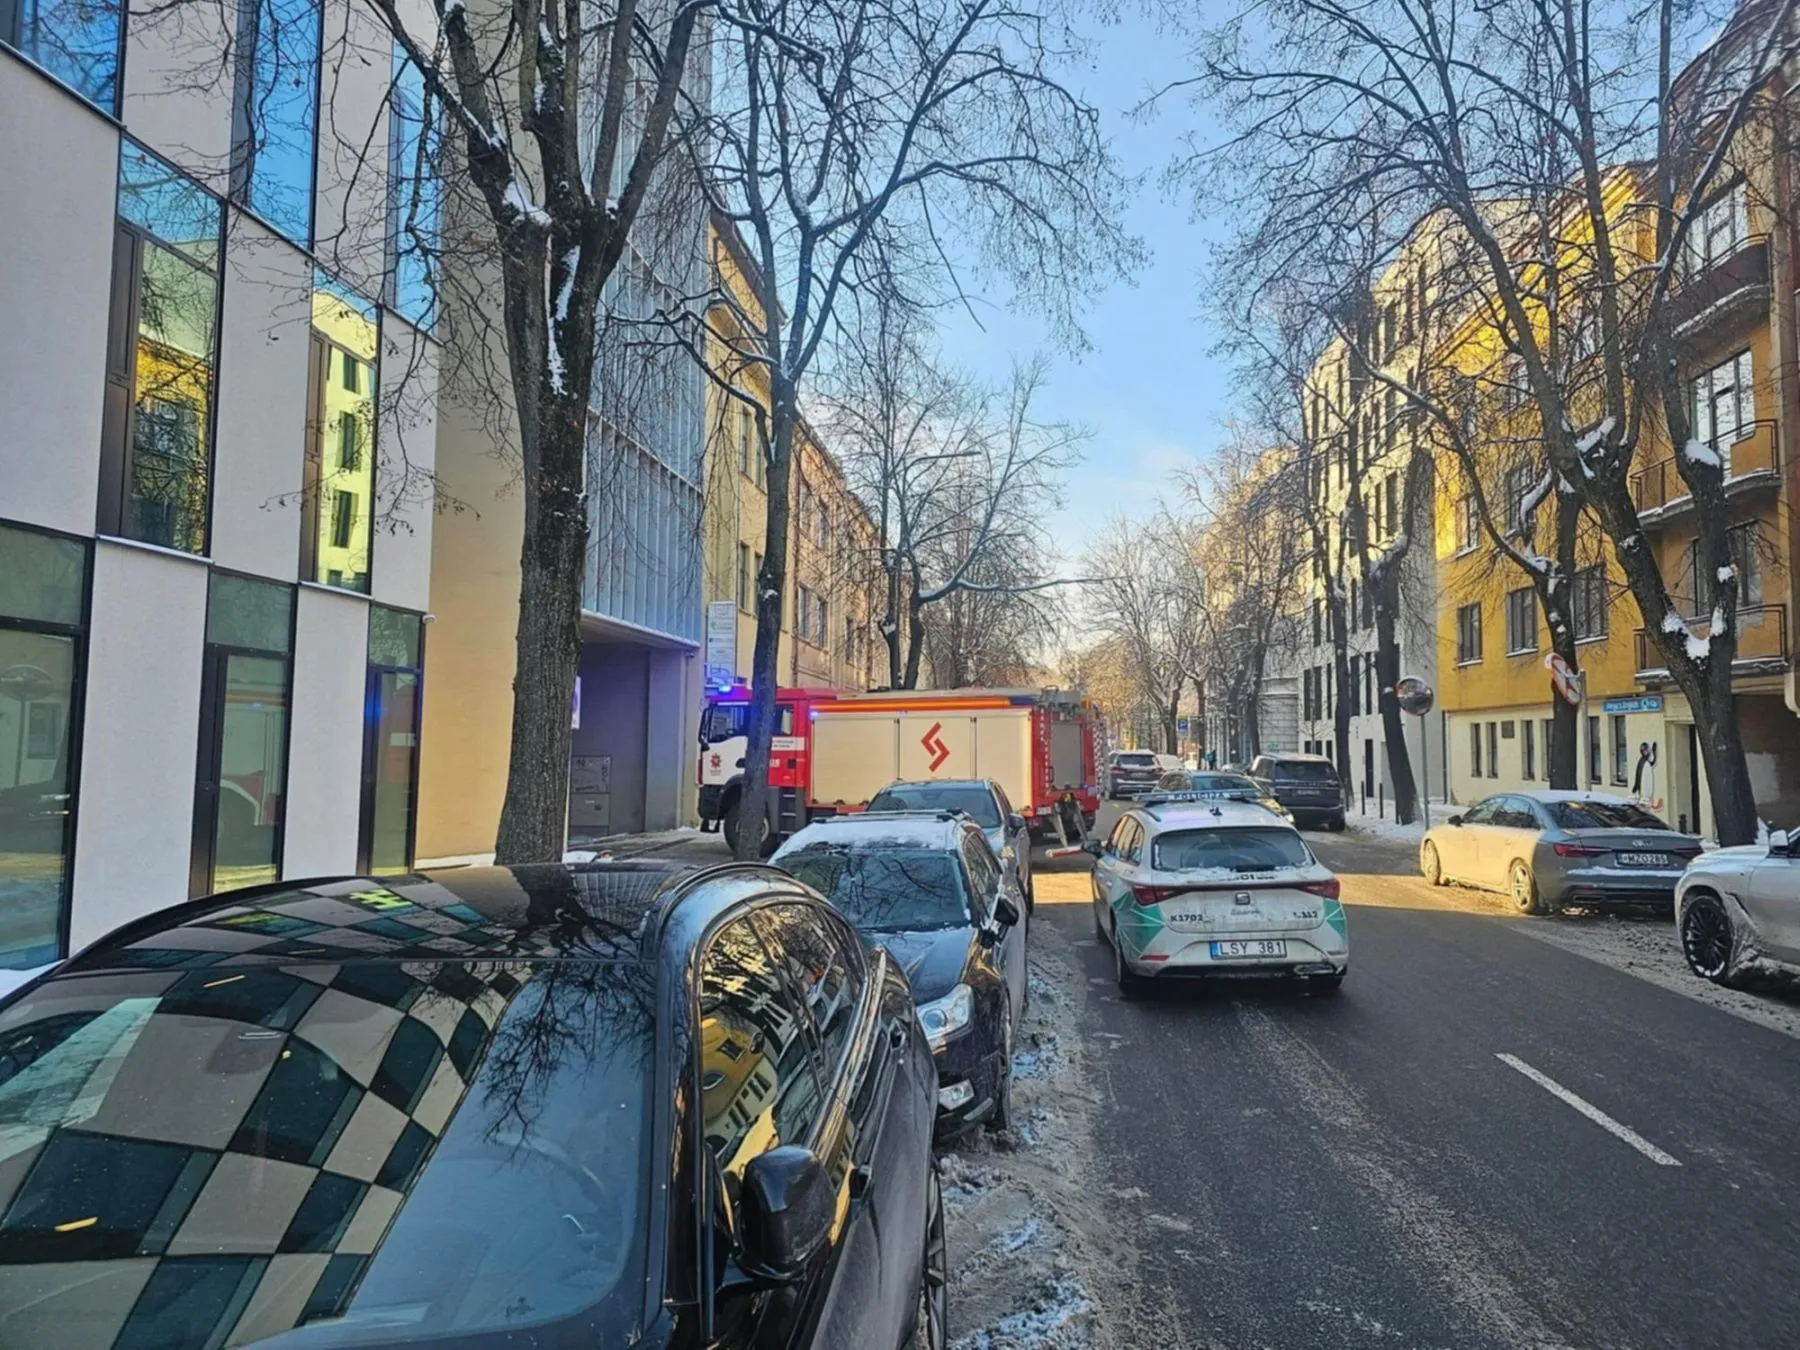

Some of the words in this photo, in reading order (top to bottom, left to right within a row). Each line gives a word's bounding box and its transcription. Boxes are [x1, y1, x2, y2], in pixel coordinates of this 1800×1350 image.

[1174, 791, 1225, 800] POLICIJA
[1220, 941, 1249, 956] LSY
[1259, 941, 1283, 955] 381
